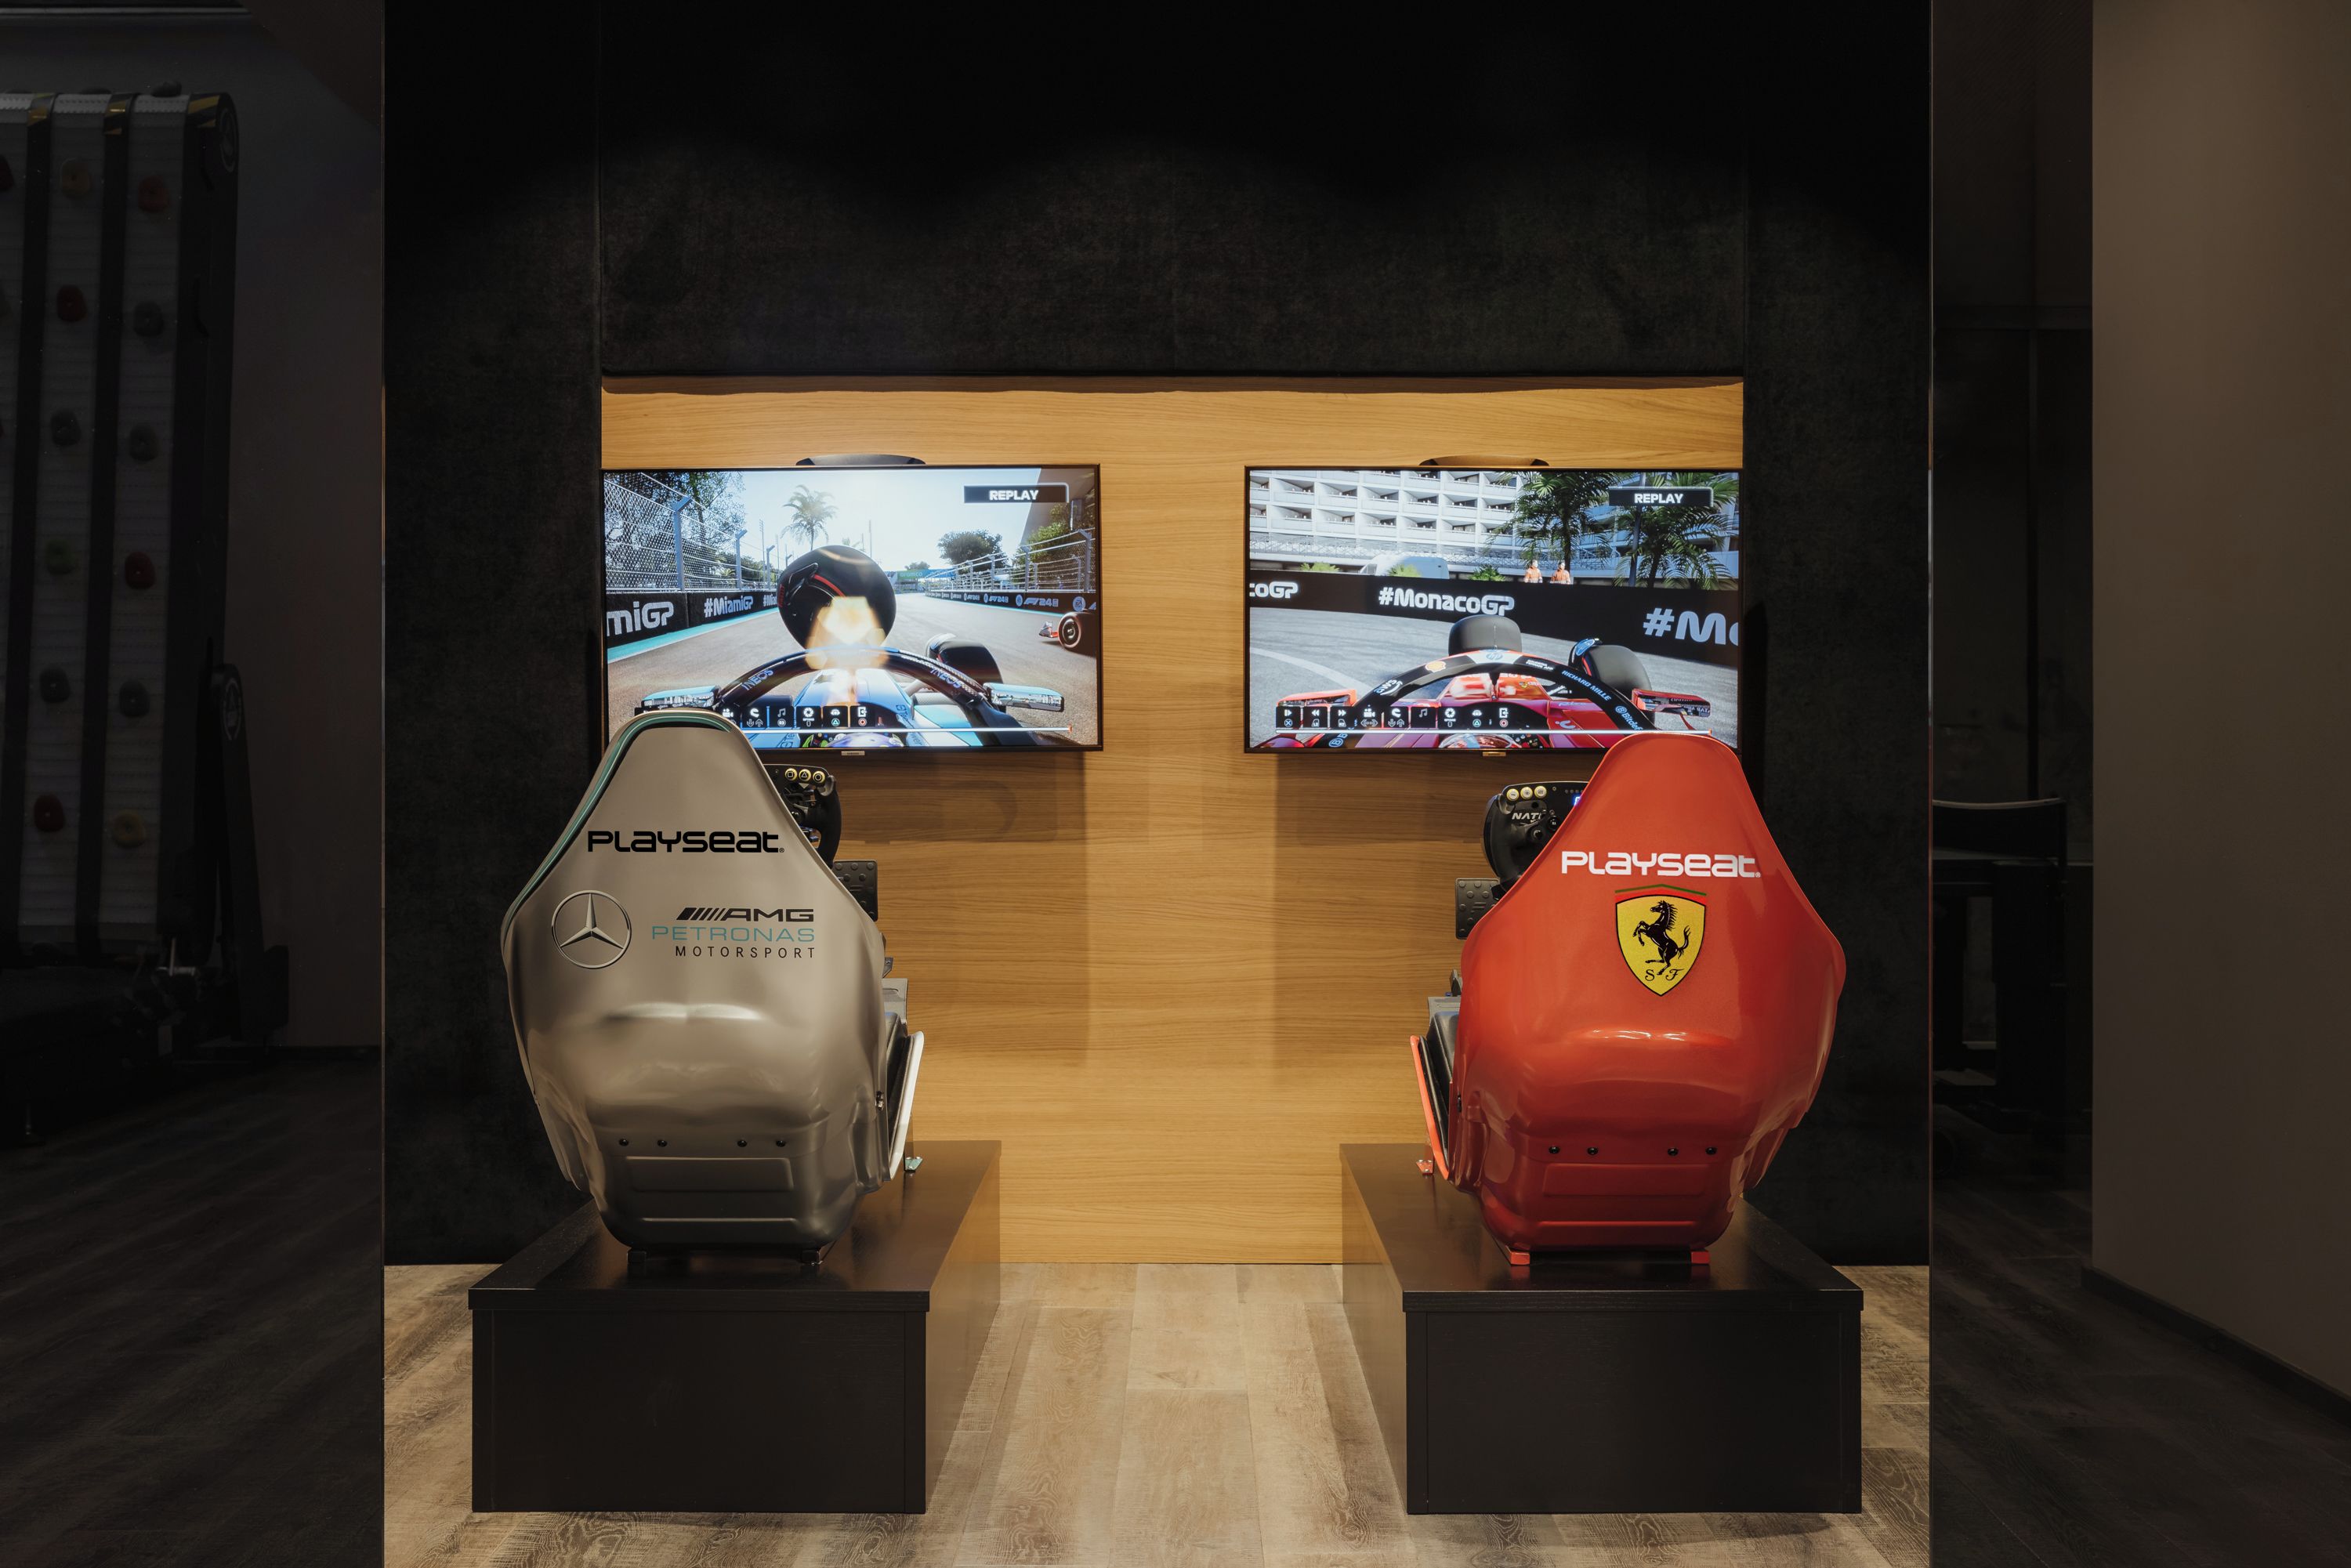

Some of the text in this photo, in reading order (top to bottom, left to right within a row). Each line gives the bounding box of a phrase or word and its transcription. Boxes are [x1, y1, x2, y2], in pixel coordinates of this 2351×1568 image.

[989, 490, 1039, 501] REPLAY
[1634, 493, 1683, 504] REPLAY
[705, 596, 754, 617] #MiamiGP
[1378, 586, 1515, 617] #MonacoGP
[741, 668, 774, 691] INEOS
[929, 667, 962, 689] INEOS
[1373, 679, 1397, 693] aws
[1561, 670, 1592, 687] RICHARD
[1589, 685, 1612, 701] MILLE
[651, 925, 815, 942] PETRONAS
[676, 946, 815, 958] MOTORSPORT
[1645, 969, 1655, 981] S
